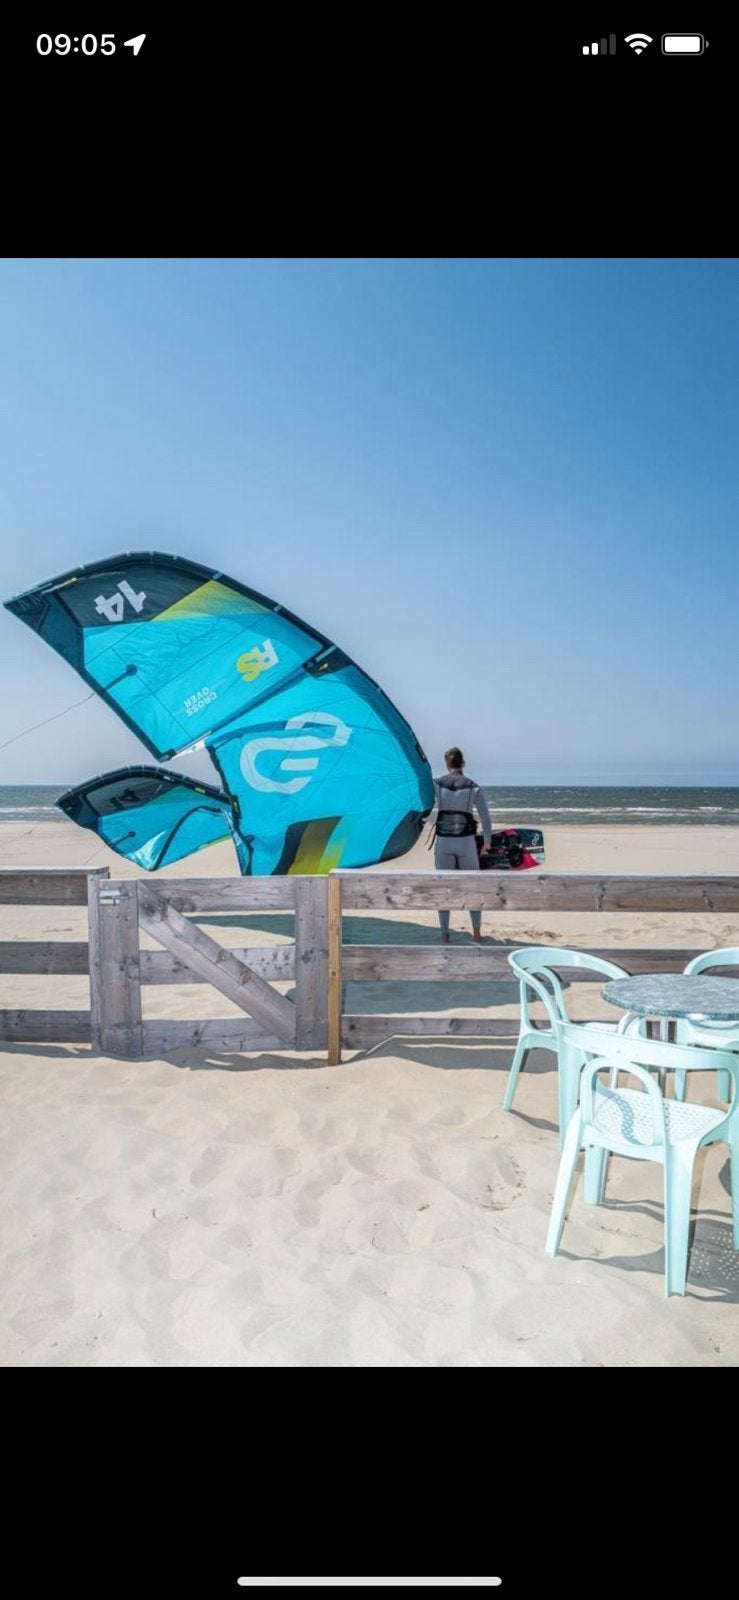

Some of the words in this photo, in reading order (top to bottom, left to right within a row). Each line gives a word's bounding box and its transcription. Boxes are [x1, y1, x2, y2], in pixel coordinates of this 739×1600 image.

[94, 579, 147, 622] 14
[236, 638, 279, 682] RS
[183, 687, 210, 708] OVER
[186, 691, 217, 717] CROSS
